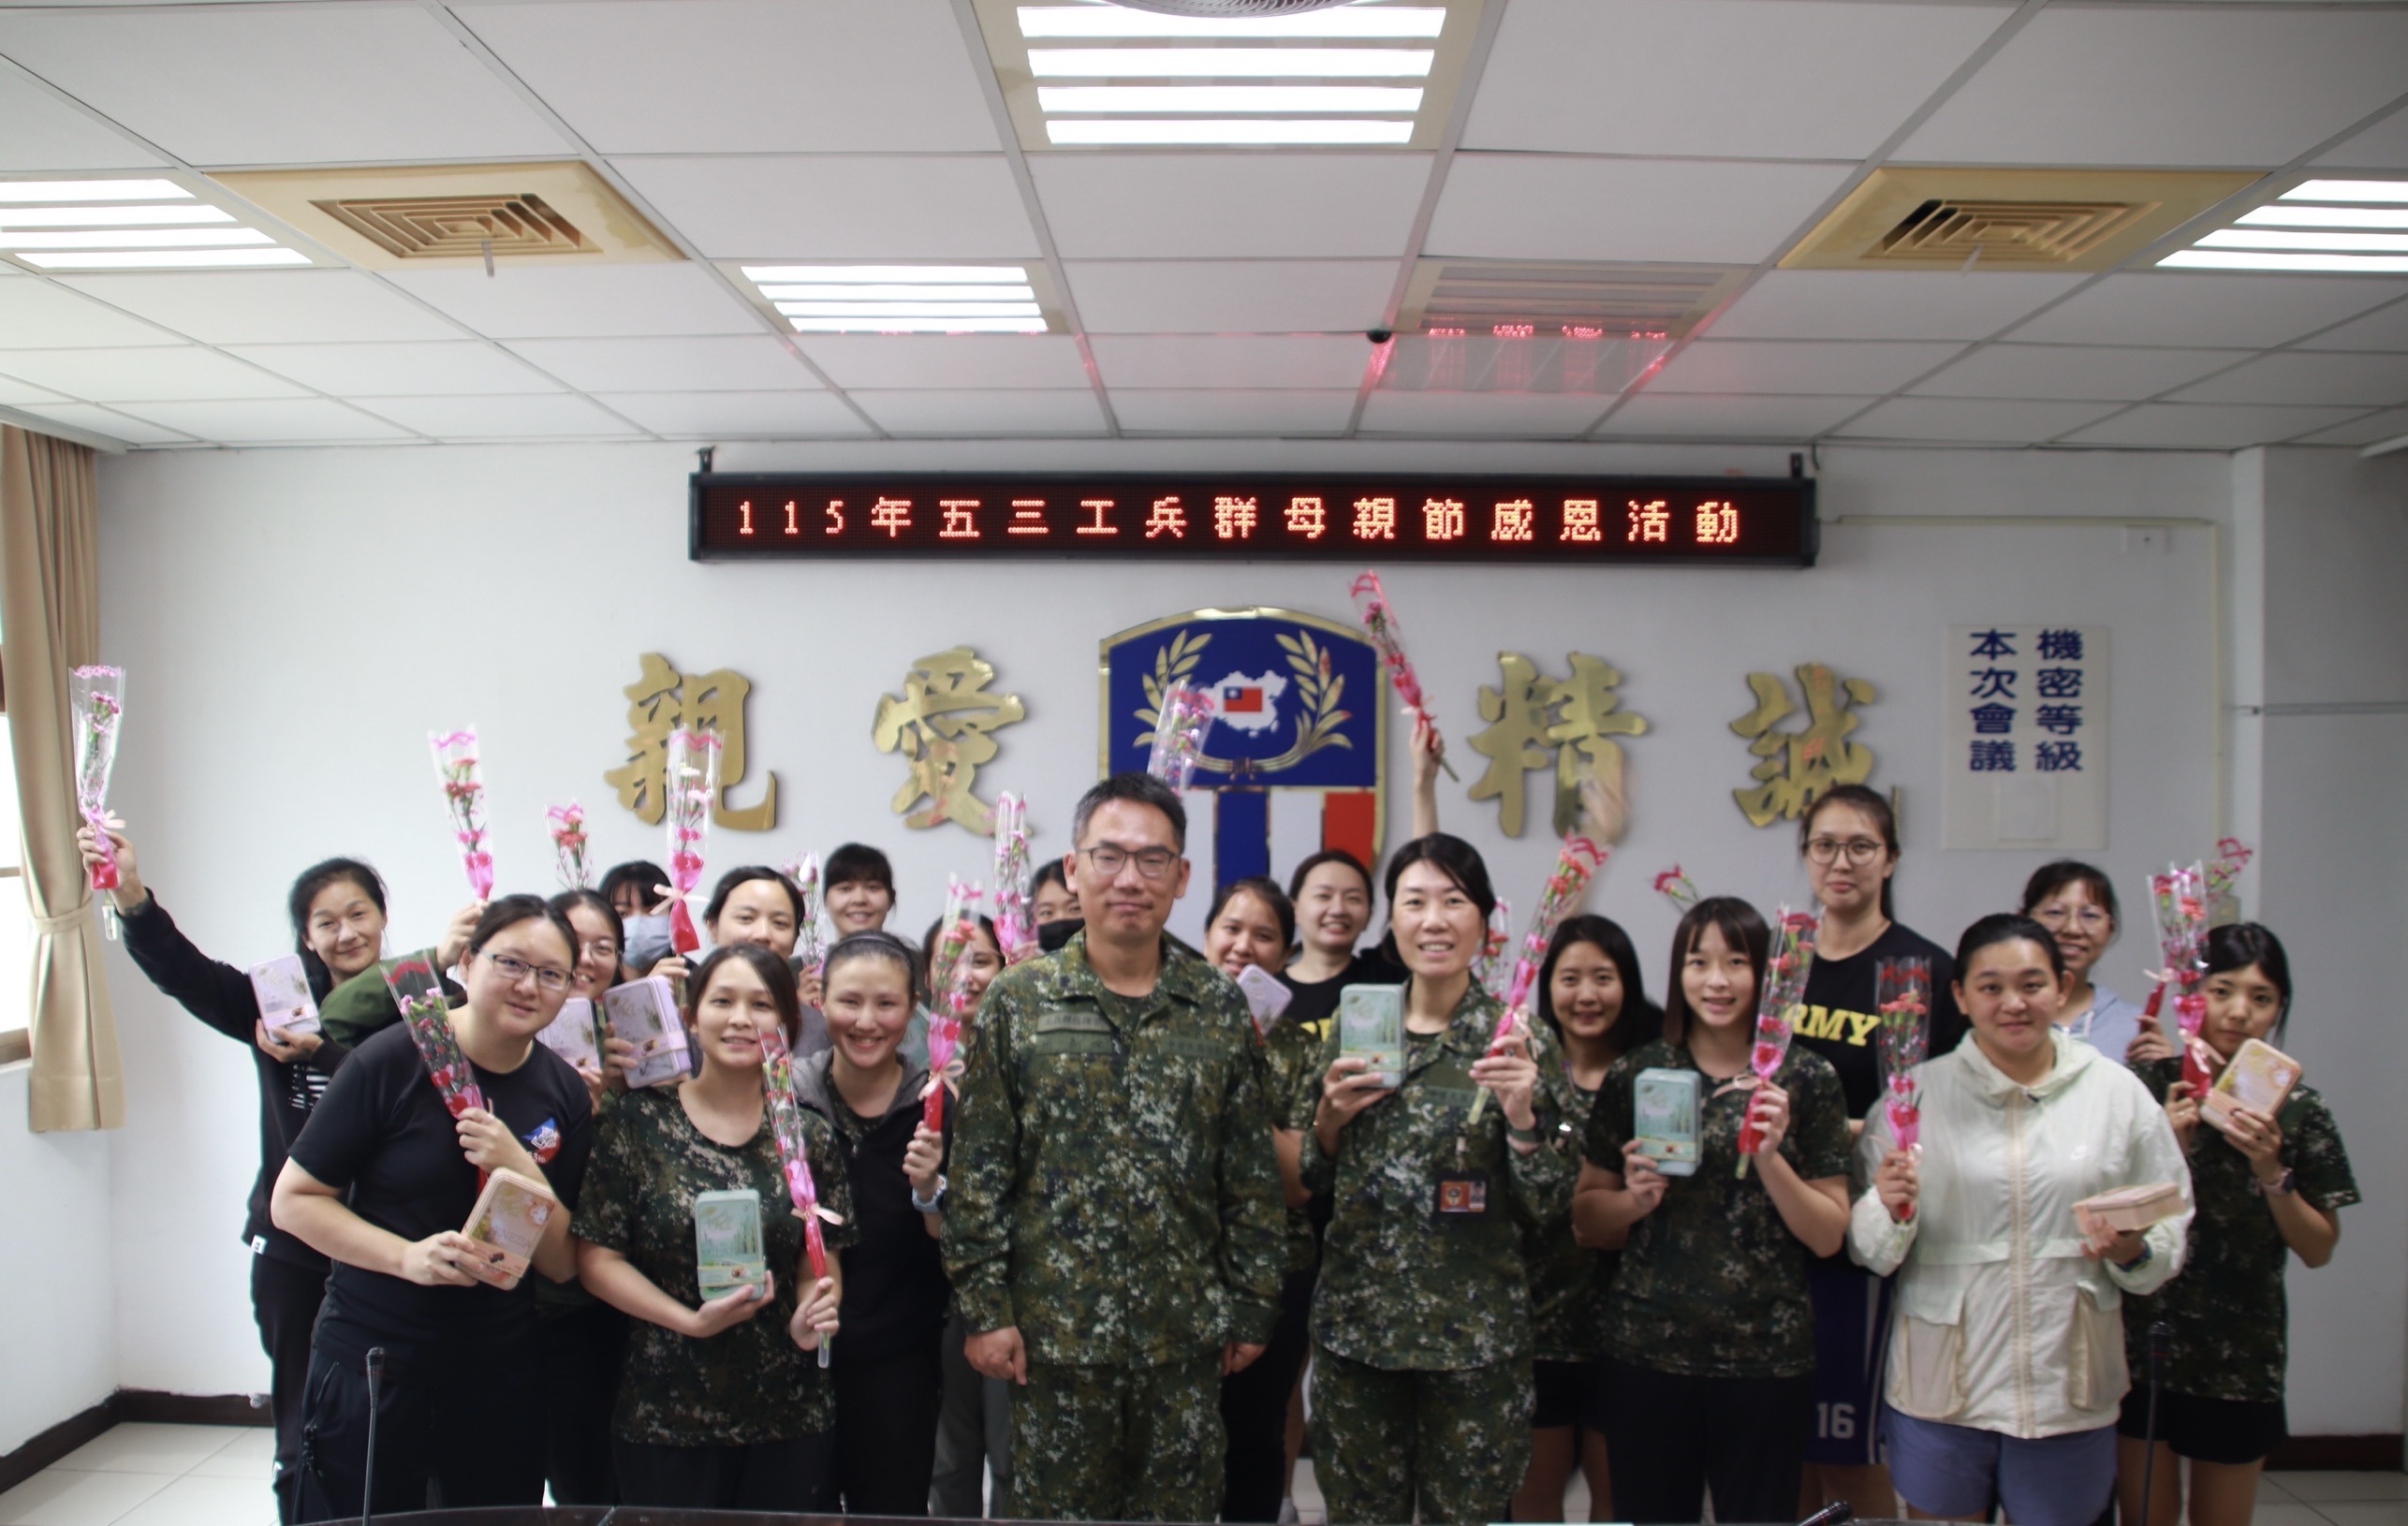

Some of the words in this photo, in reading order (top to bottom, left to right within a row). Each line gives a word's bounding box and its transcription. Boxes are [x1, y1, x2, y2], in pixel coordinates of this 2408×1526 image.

[740, 495, 1738, 543] 115年五三工兵群母親節感恩活動
[1969, 628, 2018, 771] 本次會議
[2035, 628, 2083, 771] 機密等級
[1784, 1002, 1882, 1047] RMY
[1817, 1402, 1855, 1439] 16
